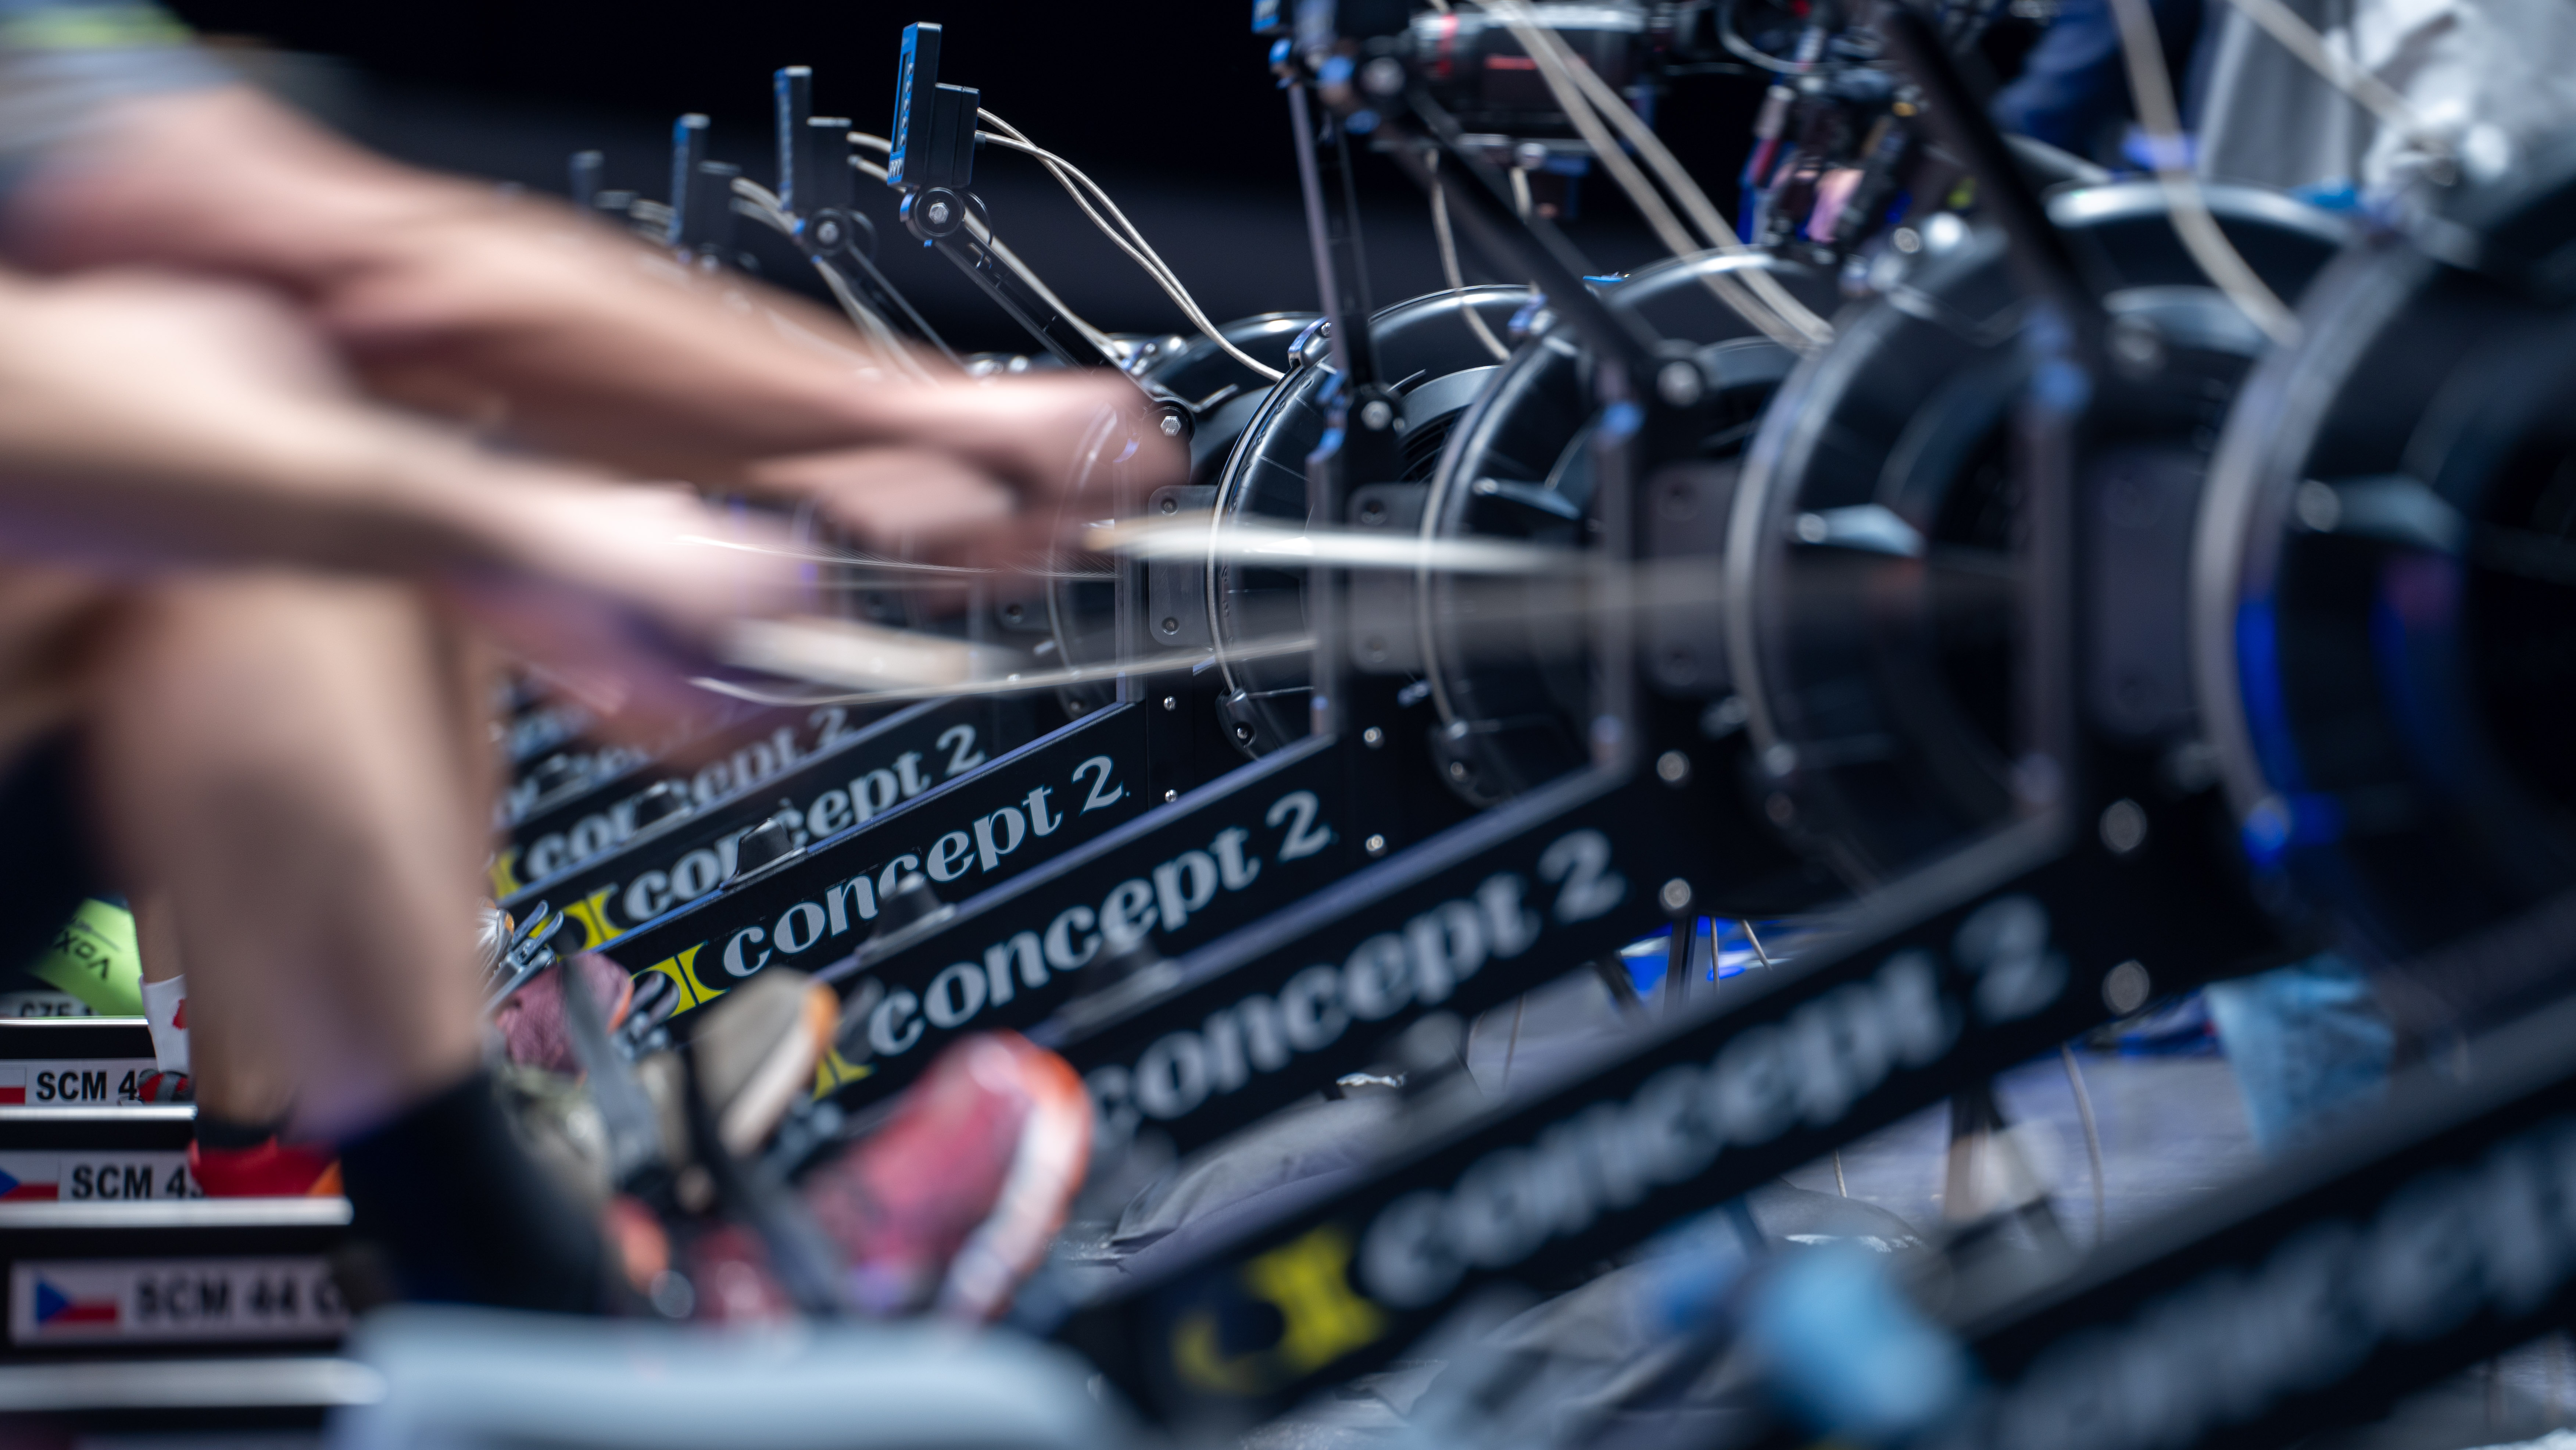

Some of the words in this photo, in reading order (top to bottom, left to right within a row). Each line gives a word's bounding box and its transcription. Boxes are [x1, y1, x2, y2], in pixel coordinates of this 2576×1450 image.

[525, 724, 807, 879] coept
[808, 704, 855, 742] 2
[936, 724, 986, 777] 2
[723, 784, 1064, 978] concept
[1072, 755, 1123, 816] 2
[867, 826, 1261, 1057] concept
[1266, 790, 1331, 860] 2
[1088, 871, 1541, 1149] concept
[1539, 827, 1629, 922] 2
[37, 1070, 107, 1101] SCM
[118, 1070, 137, 1100] 4
[1360, 947, 1960, 1309] concept
[1952, 894, 2070, 1026] 2
[72, 1163, 153, 1199] SCM
[165, 1164, 204, 1199] 4
[137, 1278, 229, 1318] SCM
